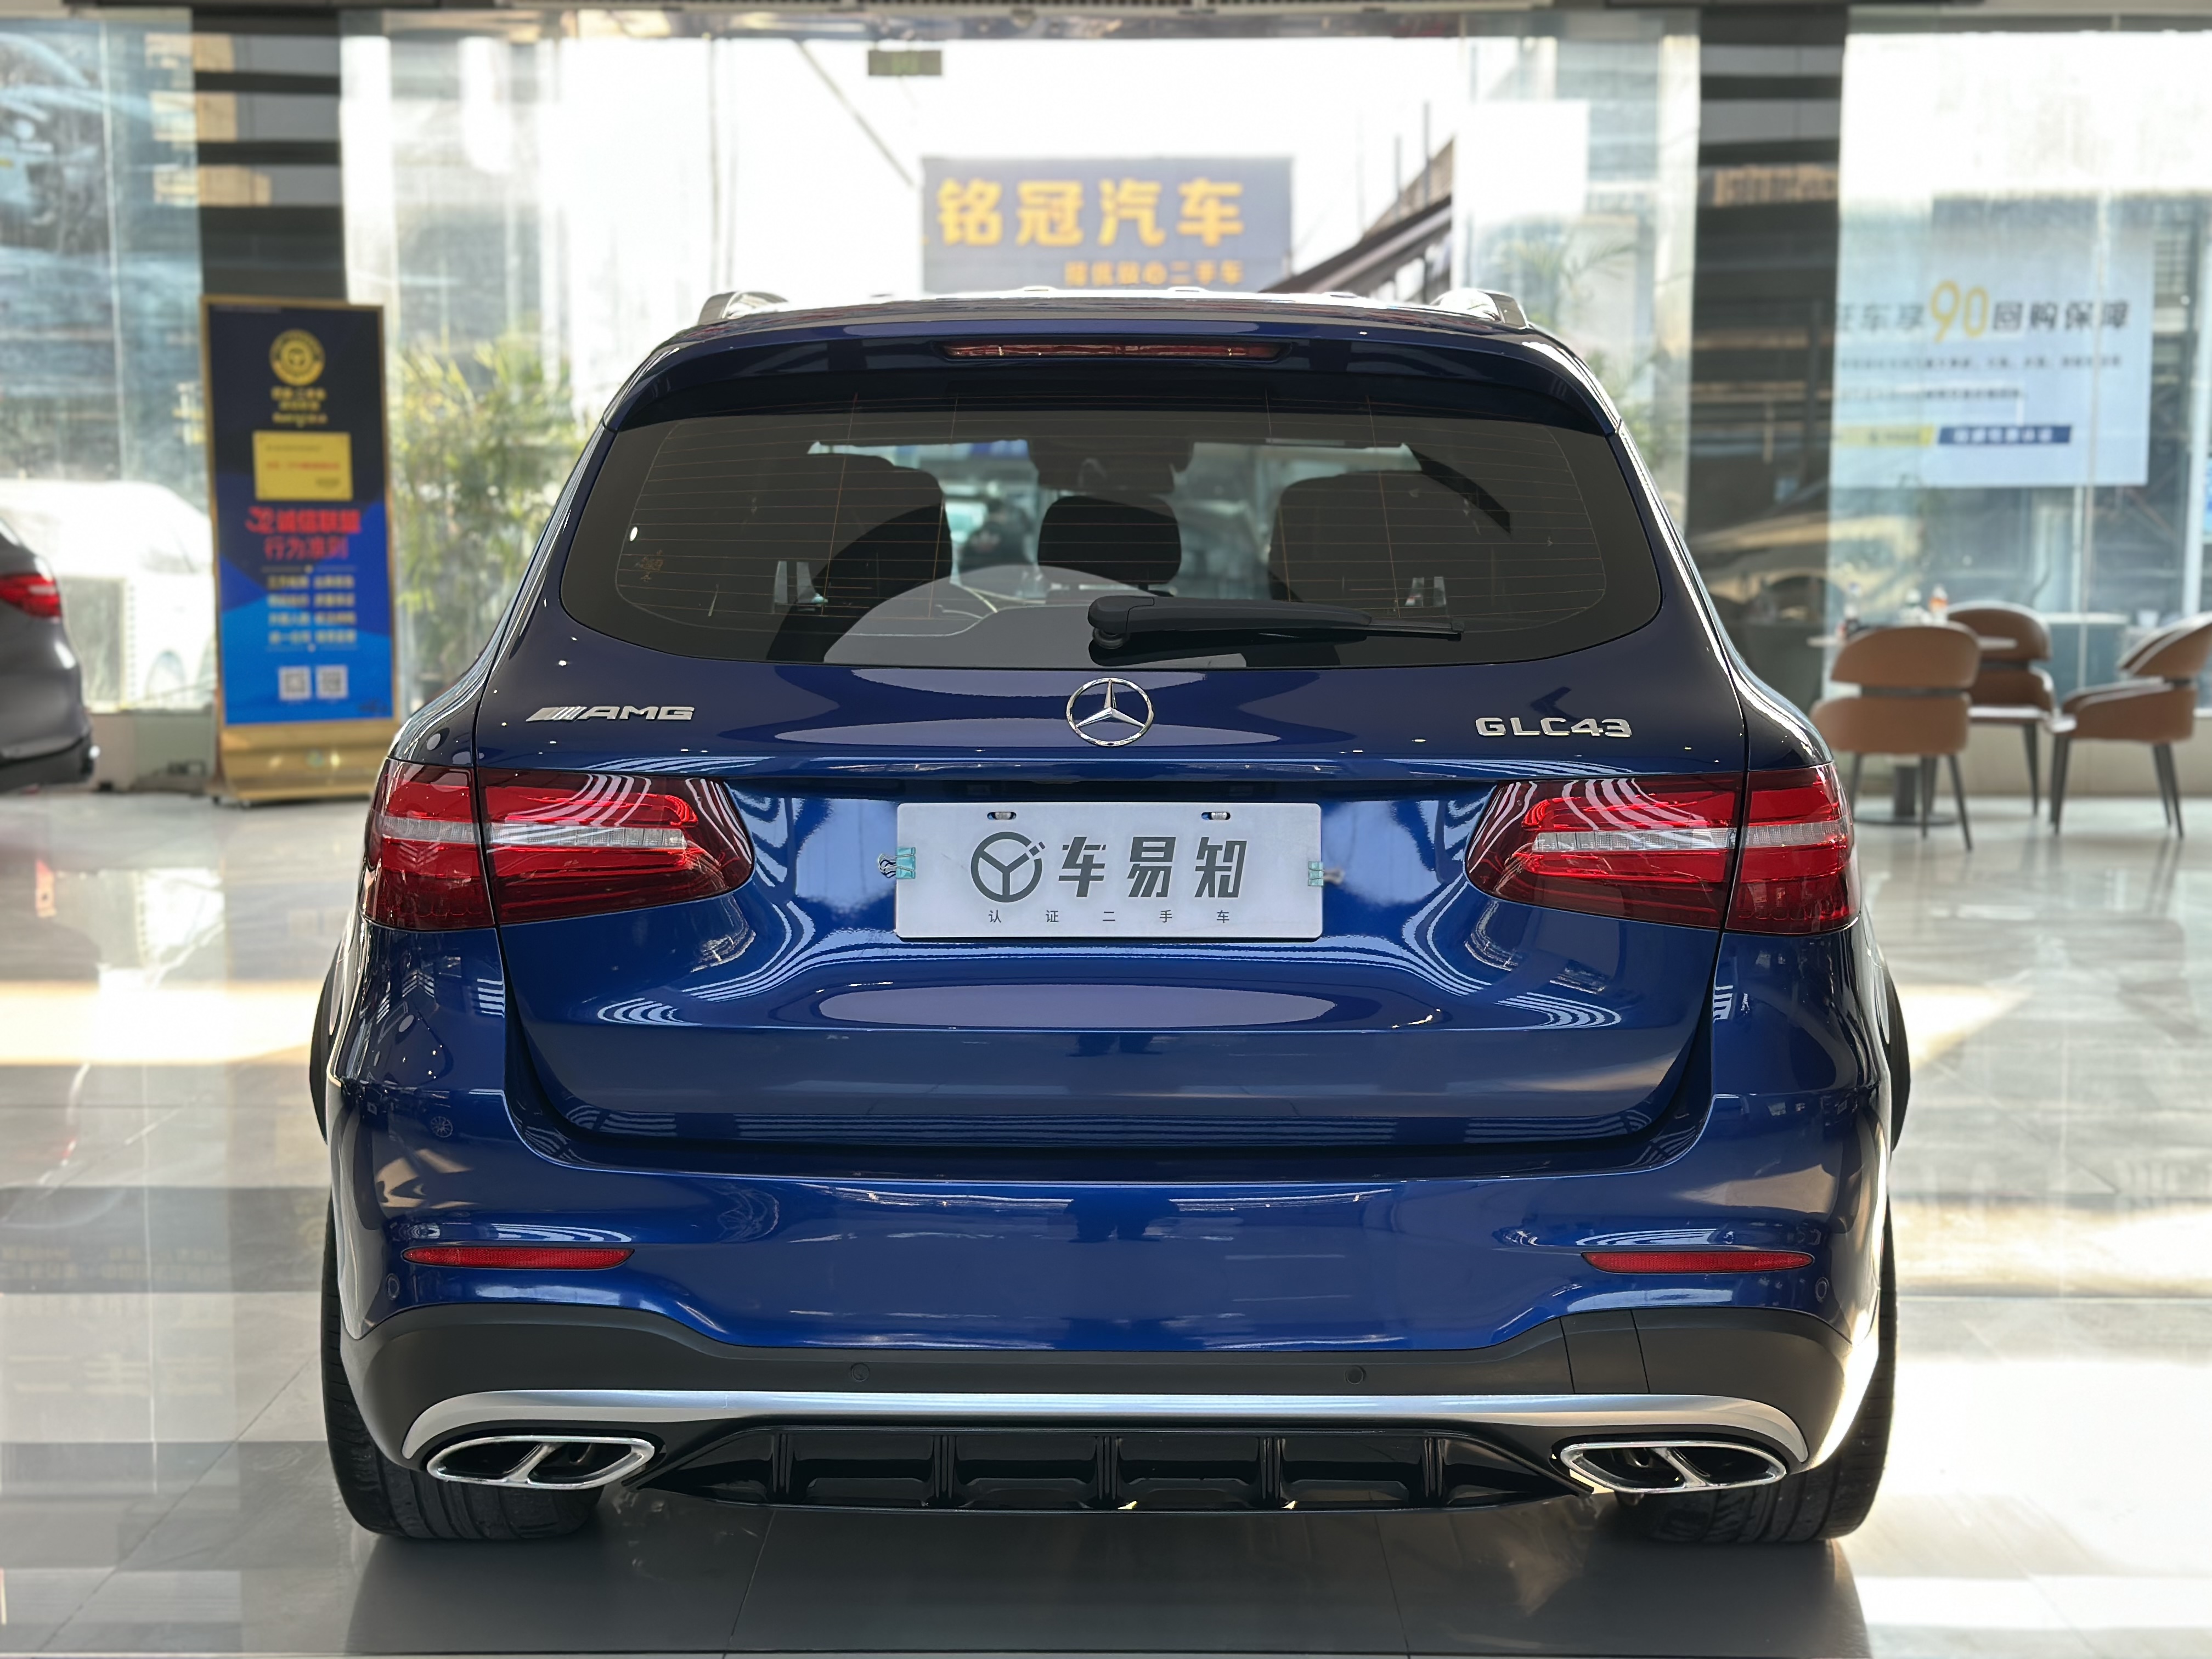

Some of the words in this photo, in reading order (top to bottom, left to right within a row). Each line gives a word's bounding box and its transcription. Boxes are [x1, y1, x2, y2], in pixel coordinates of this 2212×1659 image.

[936, 178, 1244, 246] 铭冠汽车
[578, 706, 695, 720] AMG
[1475, 717, 1632, 737] GLC43
[1058, 836, 1248, 898] 车易知
